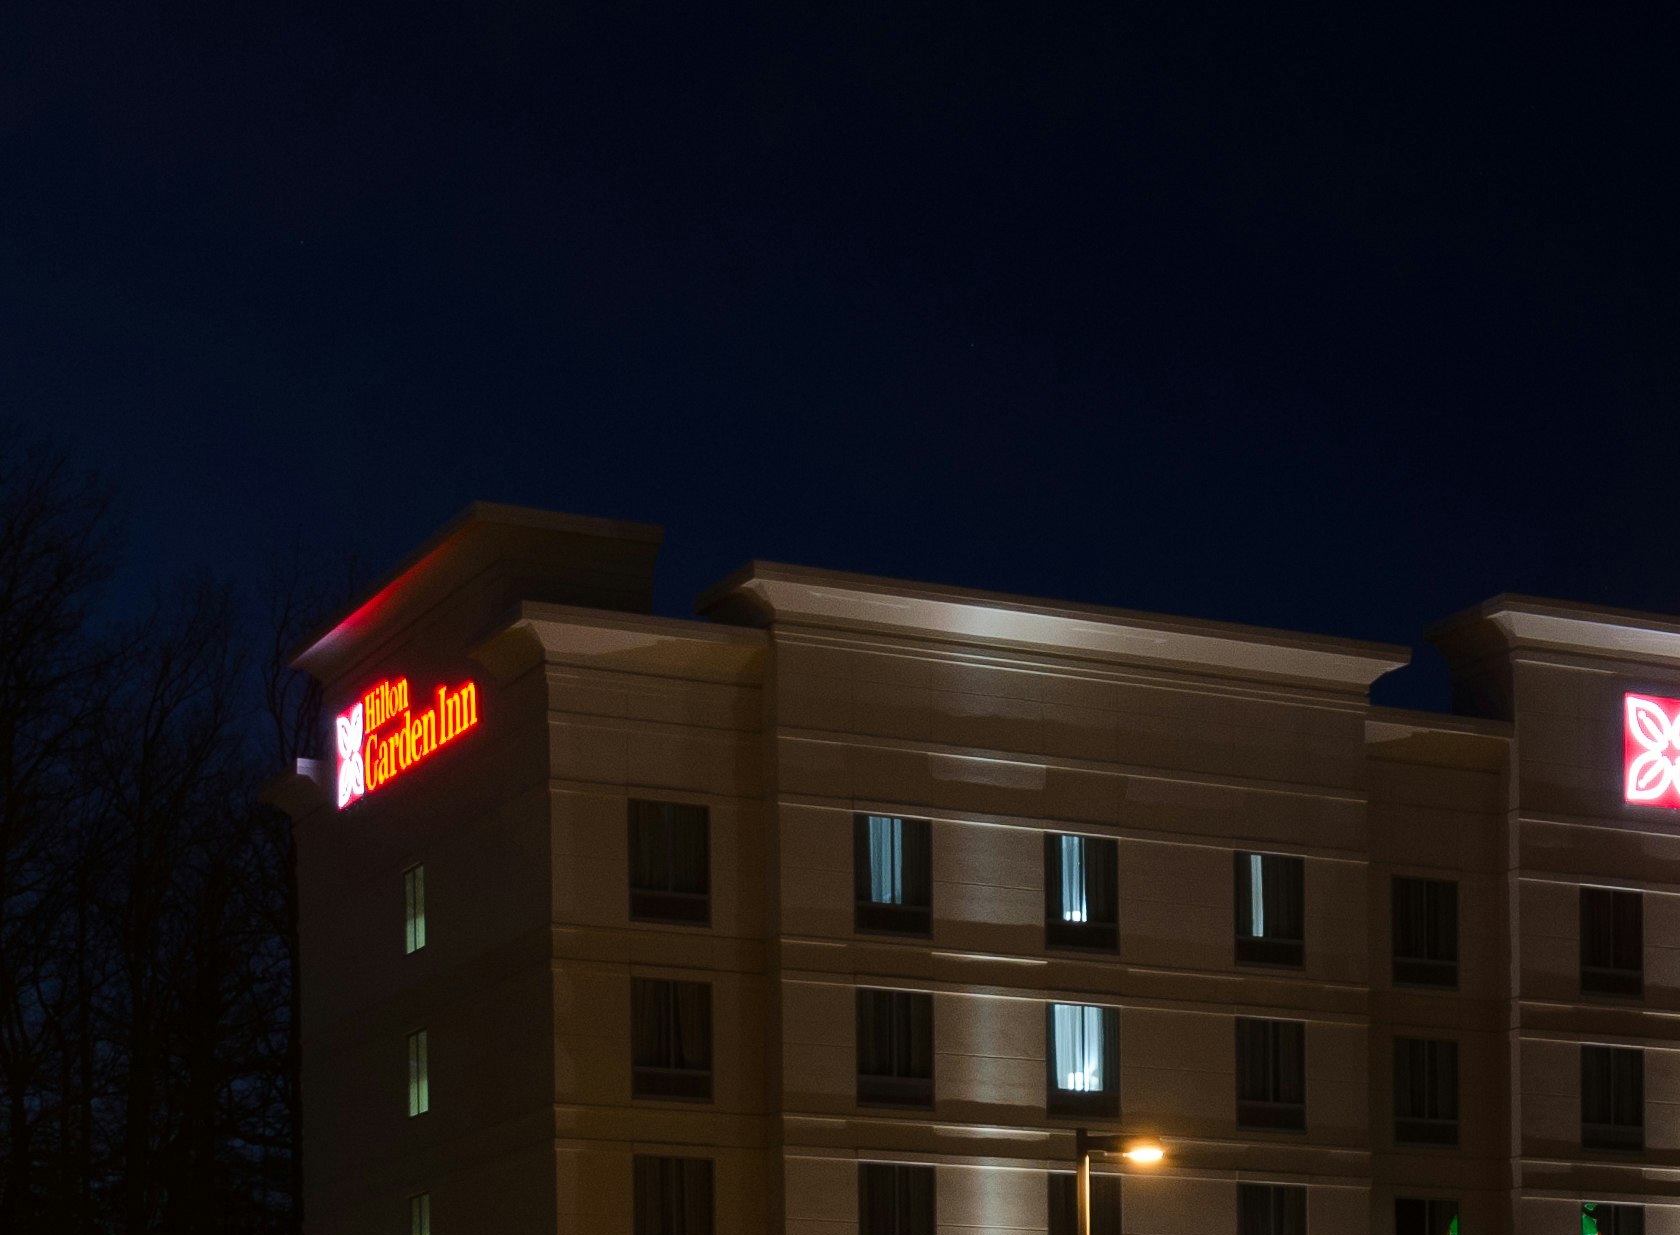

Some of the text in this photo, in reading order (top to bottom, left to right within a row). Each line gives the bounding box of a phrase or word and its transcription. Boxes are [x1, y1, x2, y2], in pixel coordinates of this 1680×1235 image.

[364, 679, 409, 734] Hilton
[365, 682, 478, 791] Garden Inn
